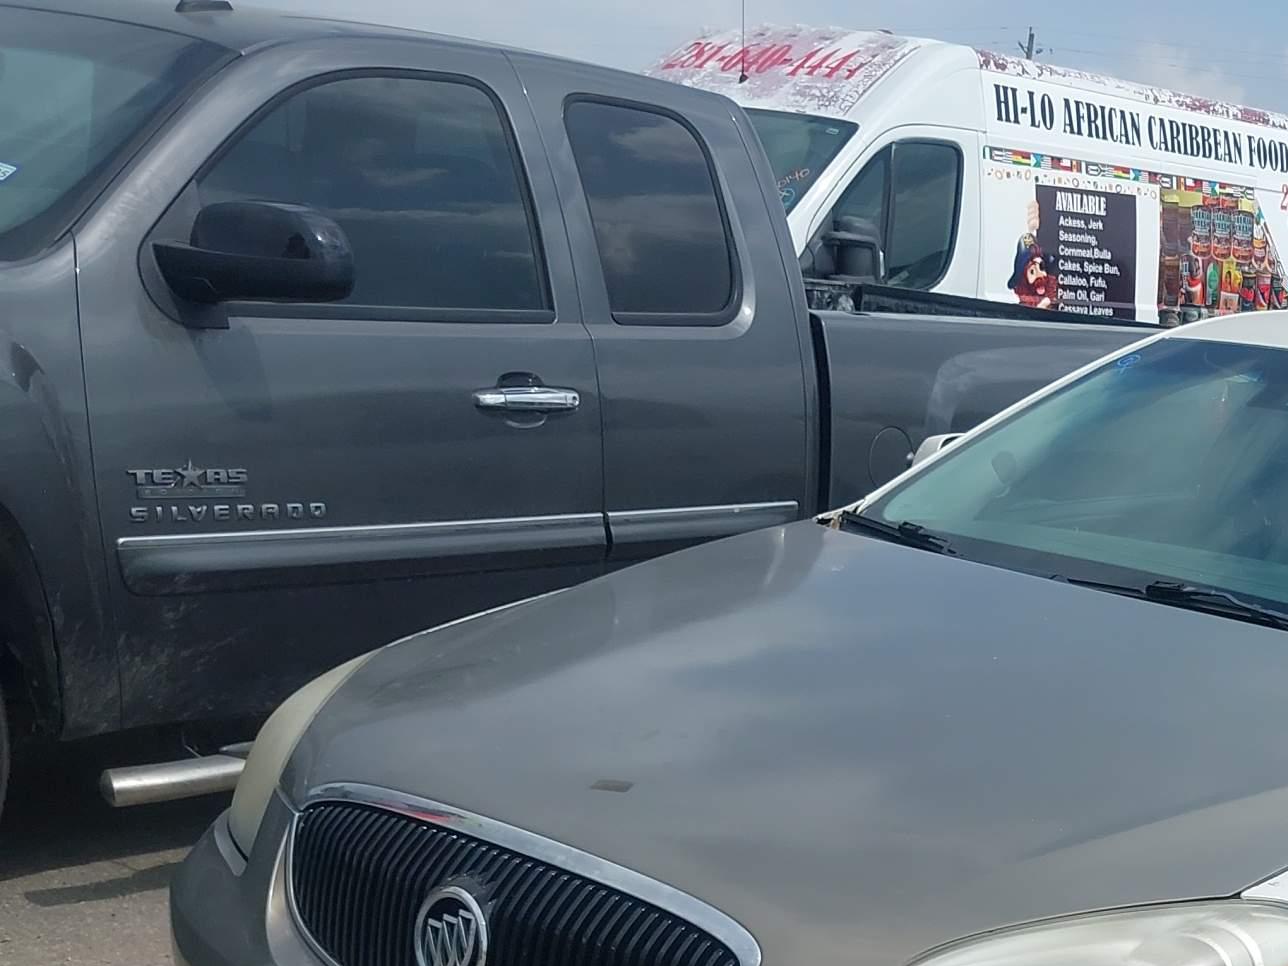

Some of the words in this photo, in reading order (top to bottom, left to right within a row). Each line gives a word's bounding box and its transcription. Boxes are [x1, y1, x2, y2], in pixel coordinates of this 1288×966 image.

[994, 84, 1054, 130] HI-LO
[1063, 98, 1141, 147] AFRICAN
[1148, 116, 1243, 166] CARIBBEAN
[1056, 191, 1106, 216] AVAILABLE
[1088, 219, 1104, 230] Jerk
[1059, 230, 1098, 246] Seasoning,
[1058, 259, 1083, 273] Cakes,
[1083, 261, 1103, 275] Spice
[1057, 288, 1075, 300] Palm
[1090, 290, 1105, 302] Gari
[1089, 304, 1114, 316] Leaves
[130, 503, 327, 523] SILVERADO
